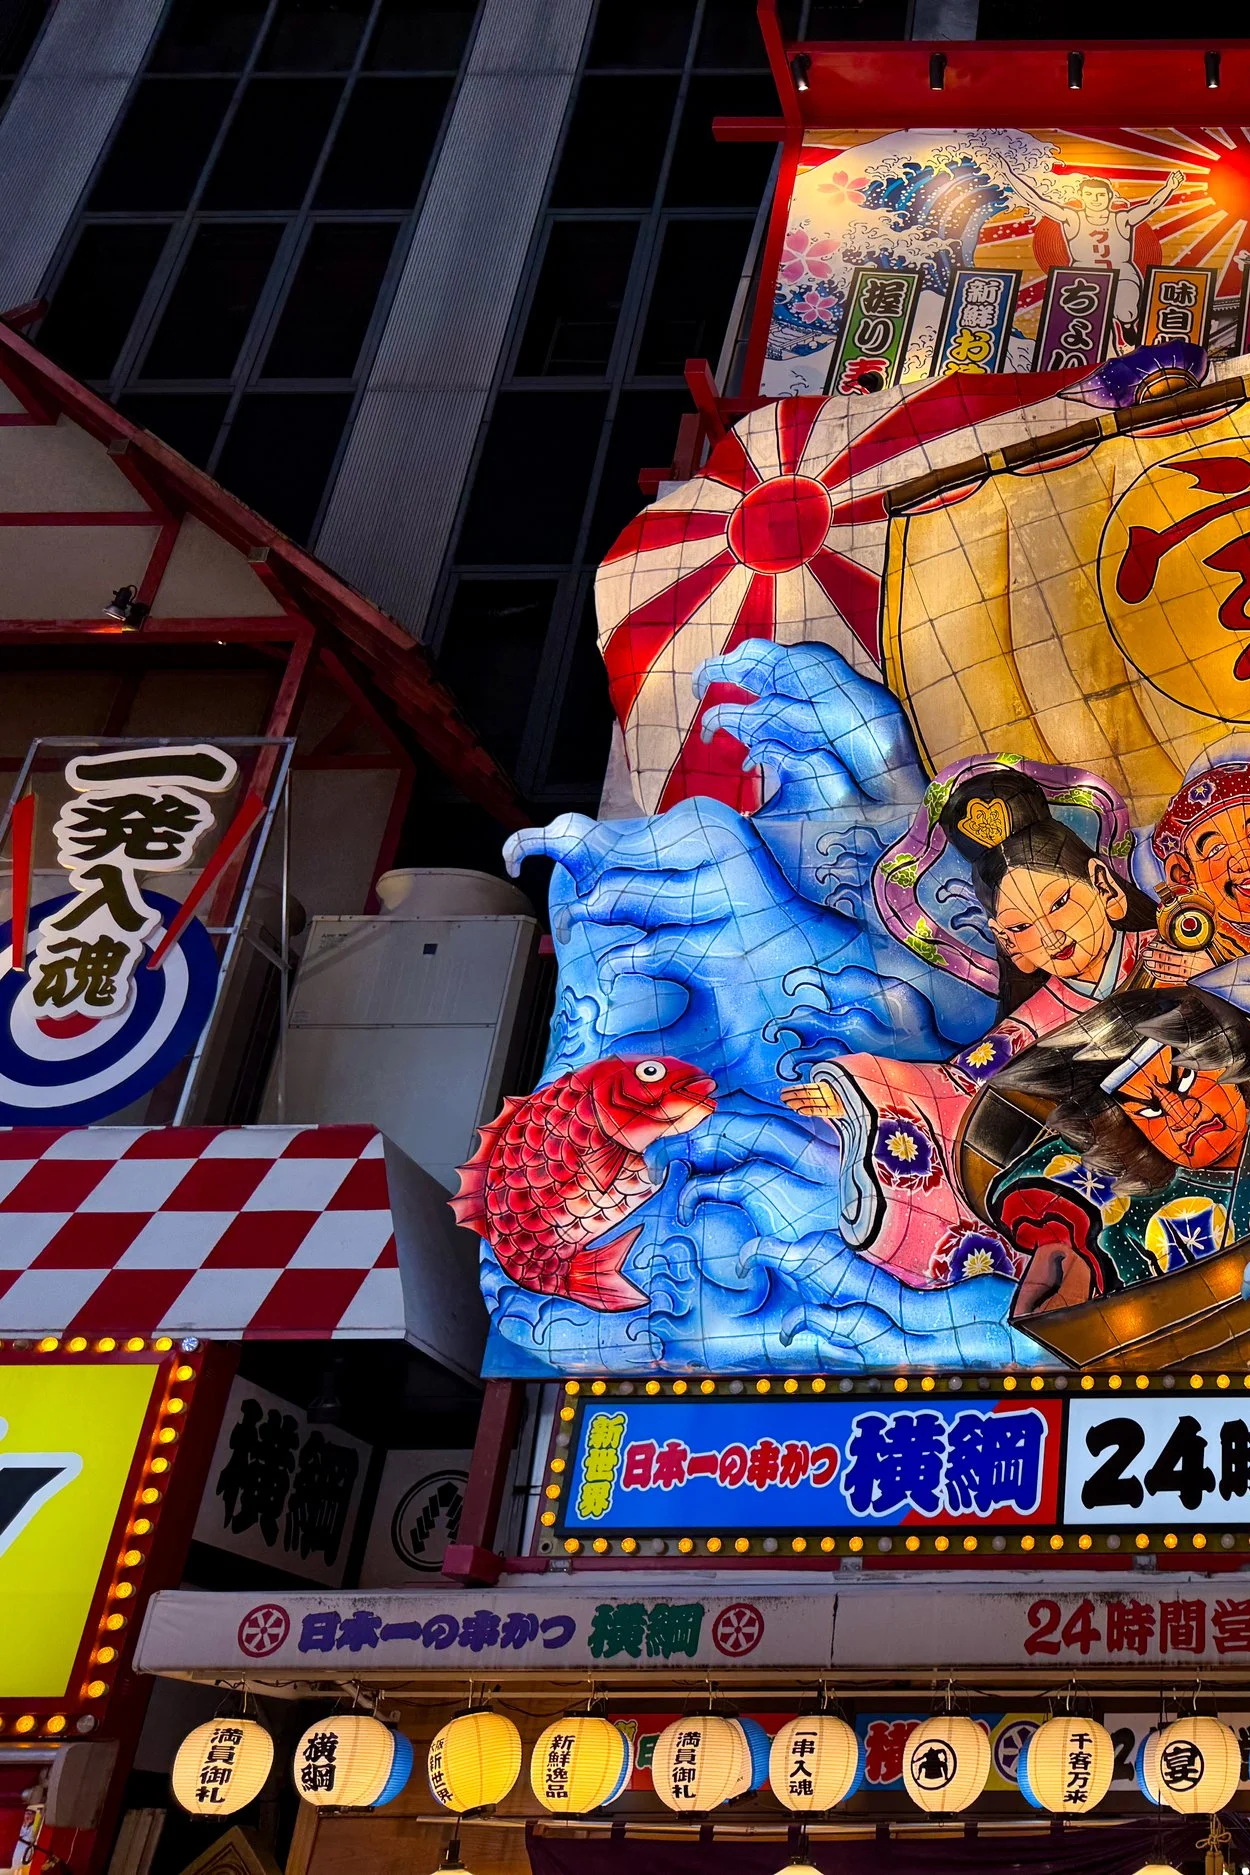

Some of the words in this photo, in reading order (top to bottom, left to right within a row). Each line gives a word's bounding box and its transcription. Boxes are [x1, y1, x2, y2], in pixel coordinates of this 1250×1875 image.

[28, 748, 234, 1013] 一発入魂
[579, 1414, 625, 1517] 新世界
[623, 1441, 838, 1489] 日本一の串かつ
[843, 1410, 1046, 1515] 横綱
[298, 1609, 576, 1653] 日本一の串かつ
[588, 1602, 706, 1659] 横綱
[300, 1732, 339, 1792] 横綱
[430, 1752, 453, 1804] 新世界
[545, 1734, 576, 1798] 新鮮逸品
[672, 1731, 701, 1799] 満員御礼
[789, 1731, 818, 1797] 一串入魂
[1063, 1732, 1092, 1804] 千客万来
[1162, 1745, 1202, 1789] 宴
